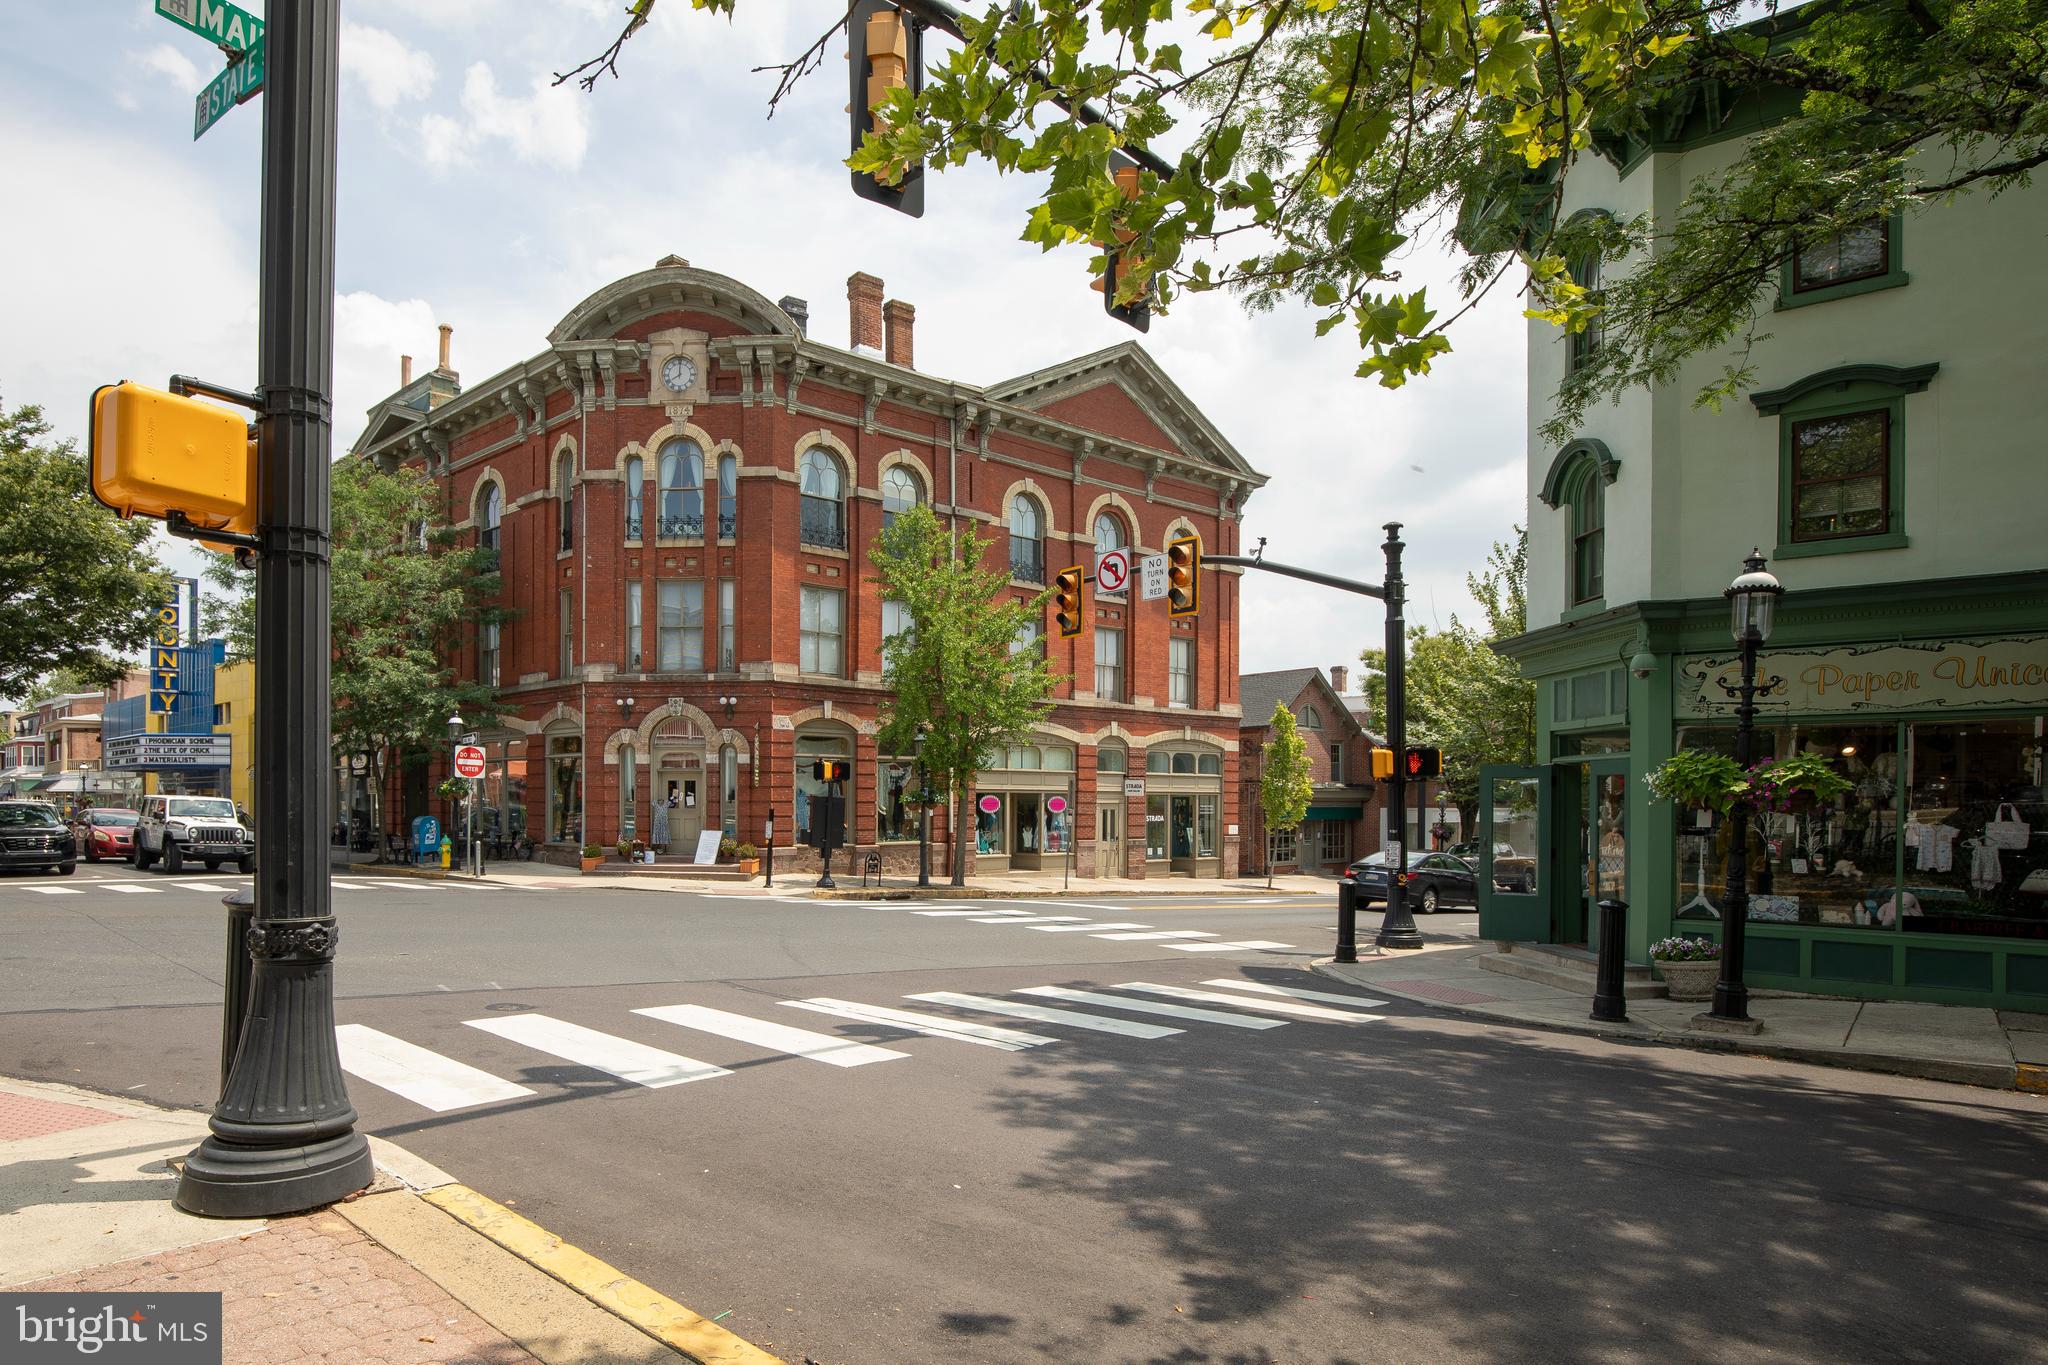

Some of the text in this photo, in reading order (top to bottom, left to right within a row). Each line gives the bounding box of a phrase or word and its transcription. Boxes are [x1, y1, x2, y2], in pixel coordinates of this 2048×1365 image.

[200, 0, 264, 50] MAI
[211, 47, 258, 116] STATE
[1148, 558, 1162, 567] NO
[1147, 569, 1164, 578] TURN
[1150, 578, 1161, 587] ON
[1149, 587, 1162, 596] RED
[1800, 664, 1920, 701] Paper
